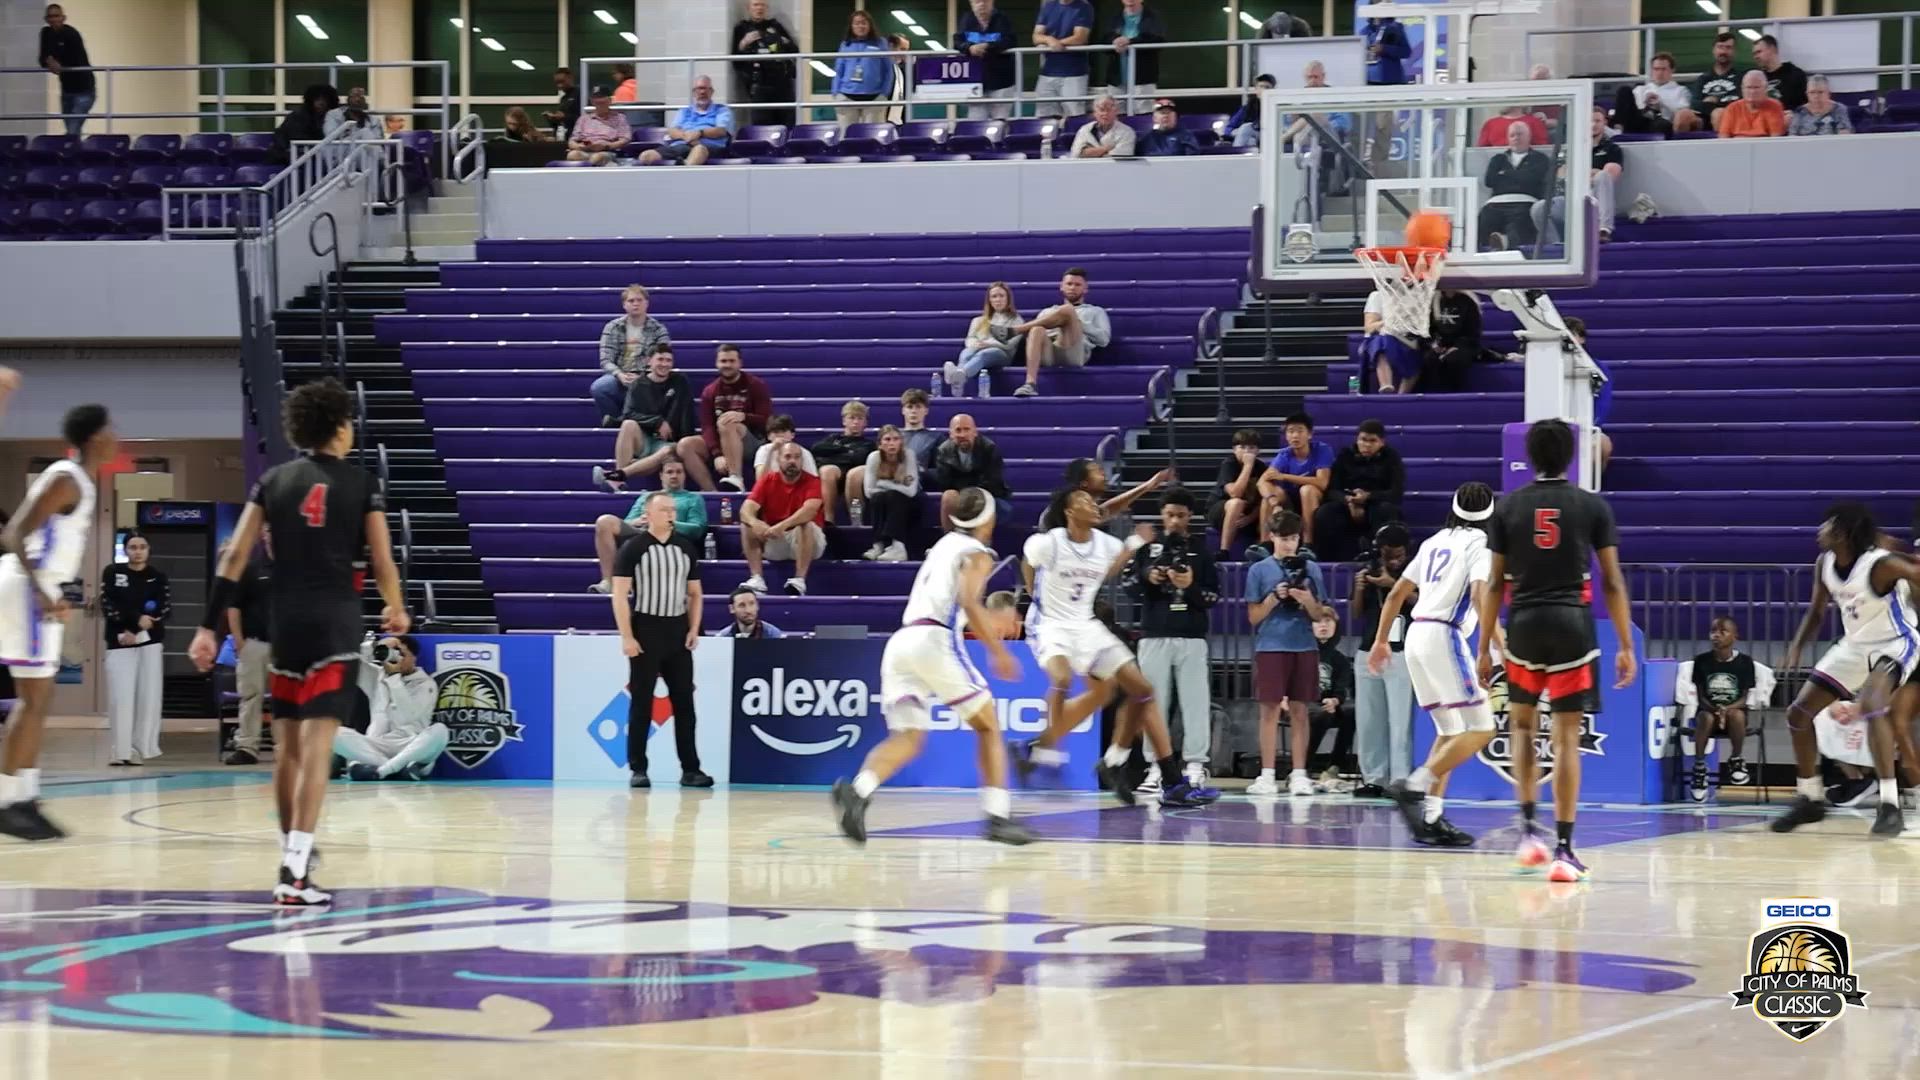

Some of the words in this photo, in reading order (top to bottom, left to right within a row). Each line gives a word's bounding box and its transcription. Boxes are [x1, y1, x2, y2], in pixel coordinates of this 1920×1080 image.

[941, 61, 970, 79] 101
[299, 483, 328, 527] 4
[165, 509, 202, 521] pepsi
[1533, 508, 1561, 550] 5
[1425, 548, 1451, 583] 12
[442, 650, 492, 660] GEICO
[457, 709, 476, 722] OF
[477, 710, 510, 726] PALMS
[927, 698, 1094, 733] GIC
[447, 728, 495, 744] LASSIC
